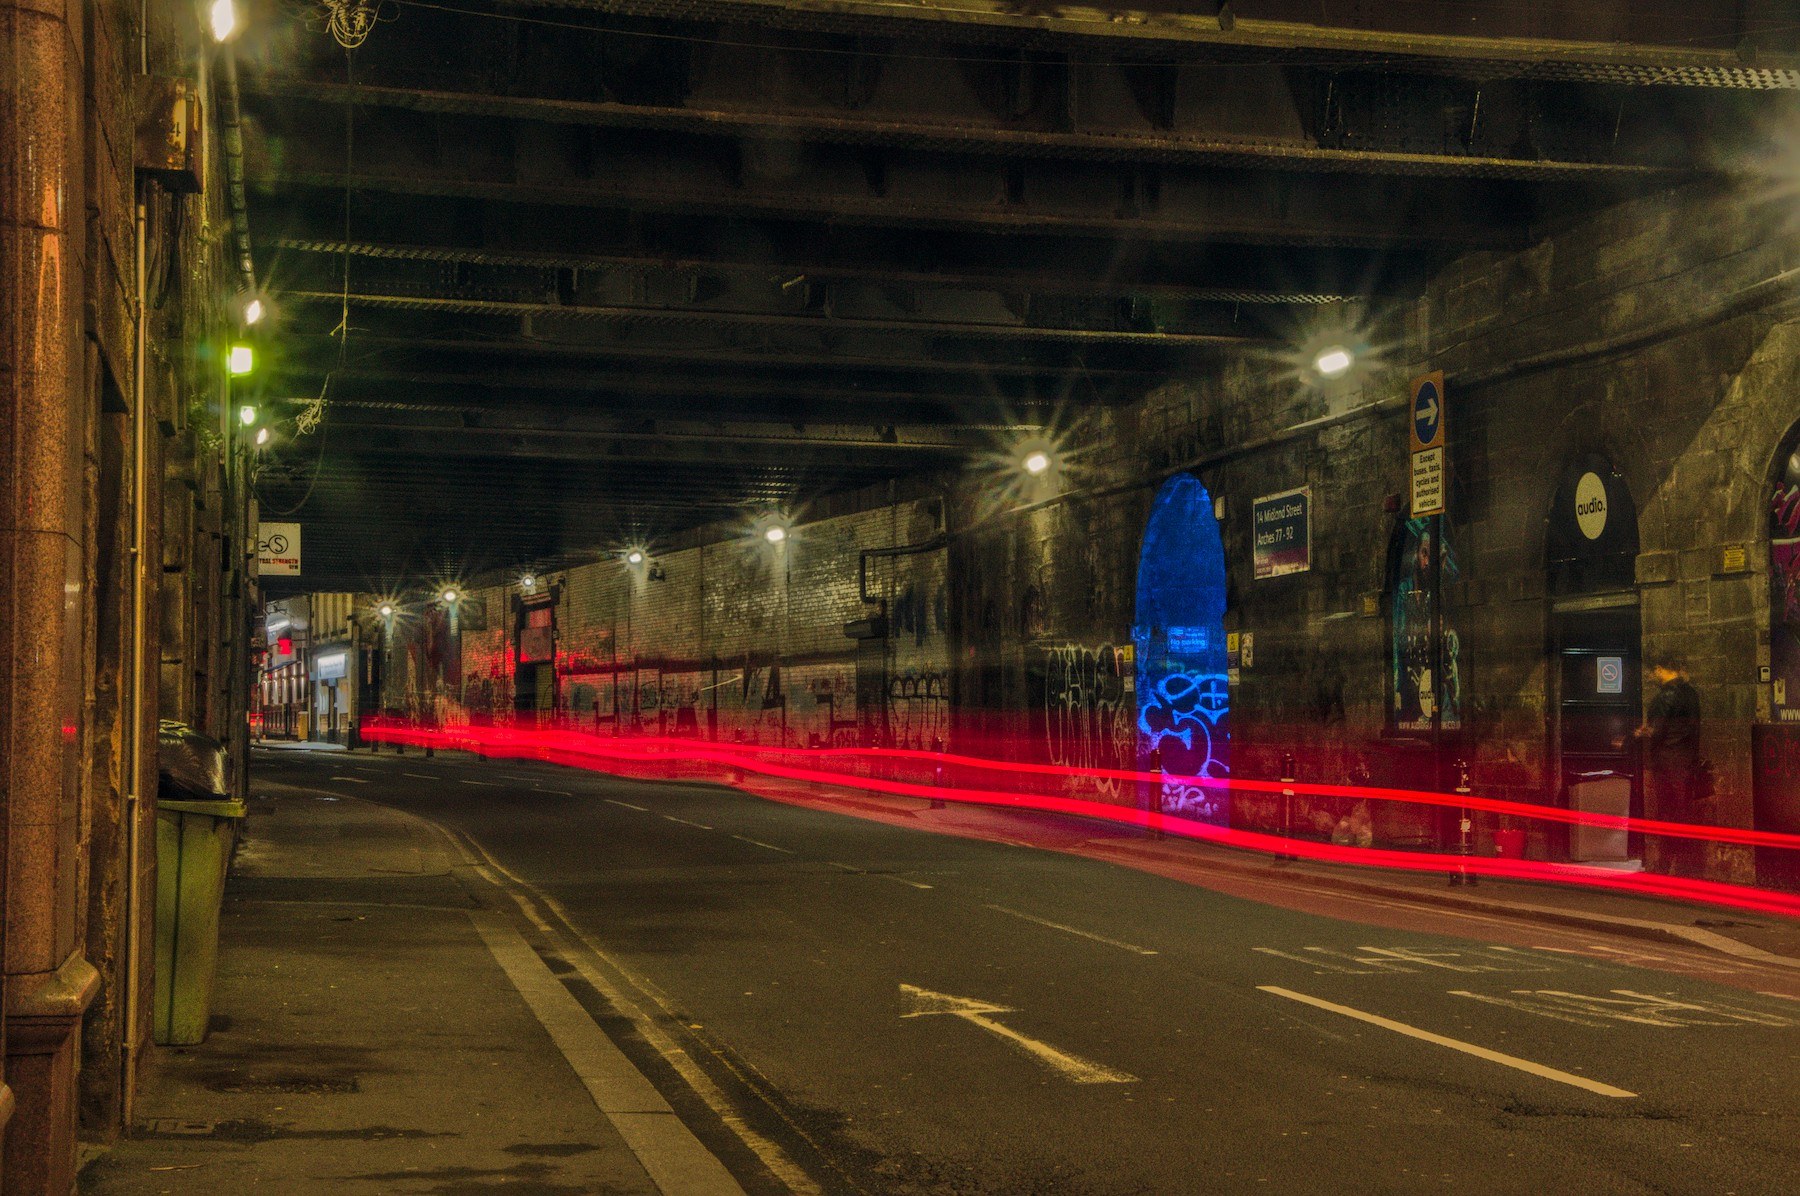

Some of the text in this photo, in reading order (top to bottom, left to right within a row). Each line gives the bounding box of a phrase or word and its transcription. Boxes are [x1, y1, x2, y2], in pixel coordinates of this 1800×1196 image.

[1419, 452, 1435, 464] Except
[1416, 473, 1439, 488] cycles and
[1416, 485, 1440, 498] authorised
[1418, 498, 1437, 508] vehicles
[1577, 498, 1606, 516] audio.
[1256, 502, 1303, 524] 14 Midland Street
[1257, 530, 1275, 546] Arches
[1275, 526, 1283, 542] 77
[1286, 525, 1294, 540] 92
